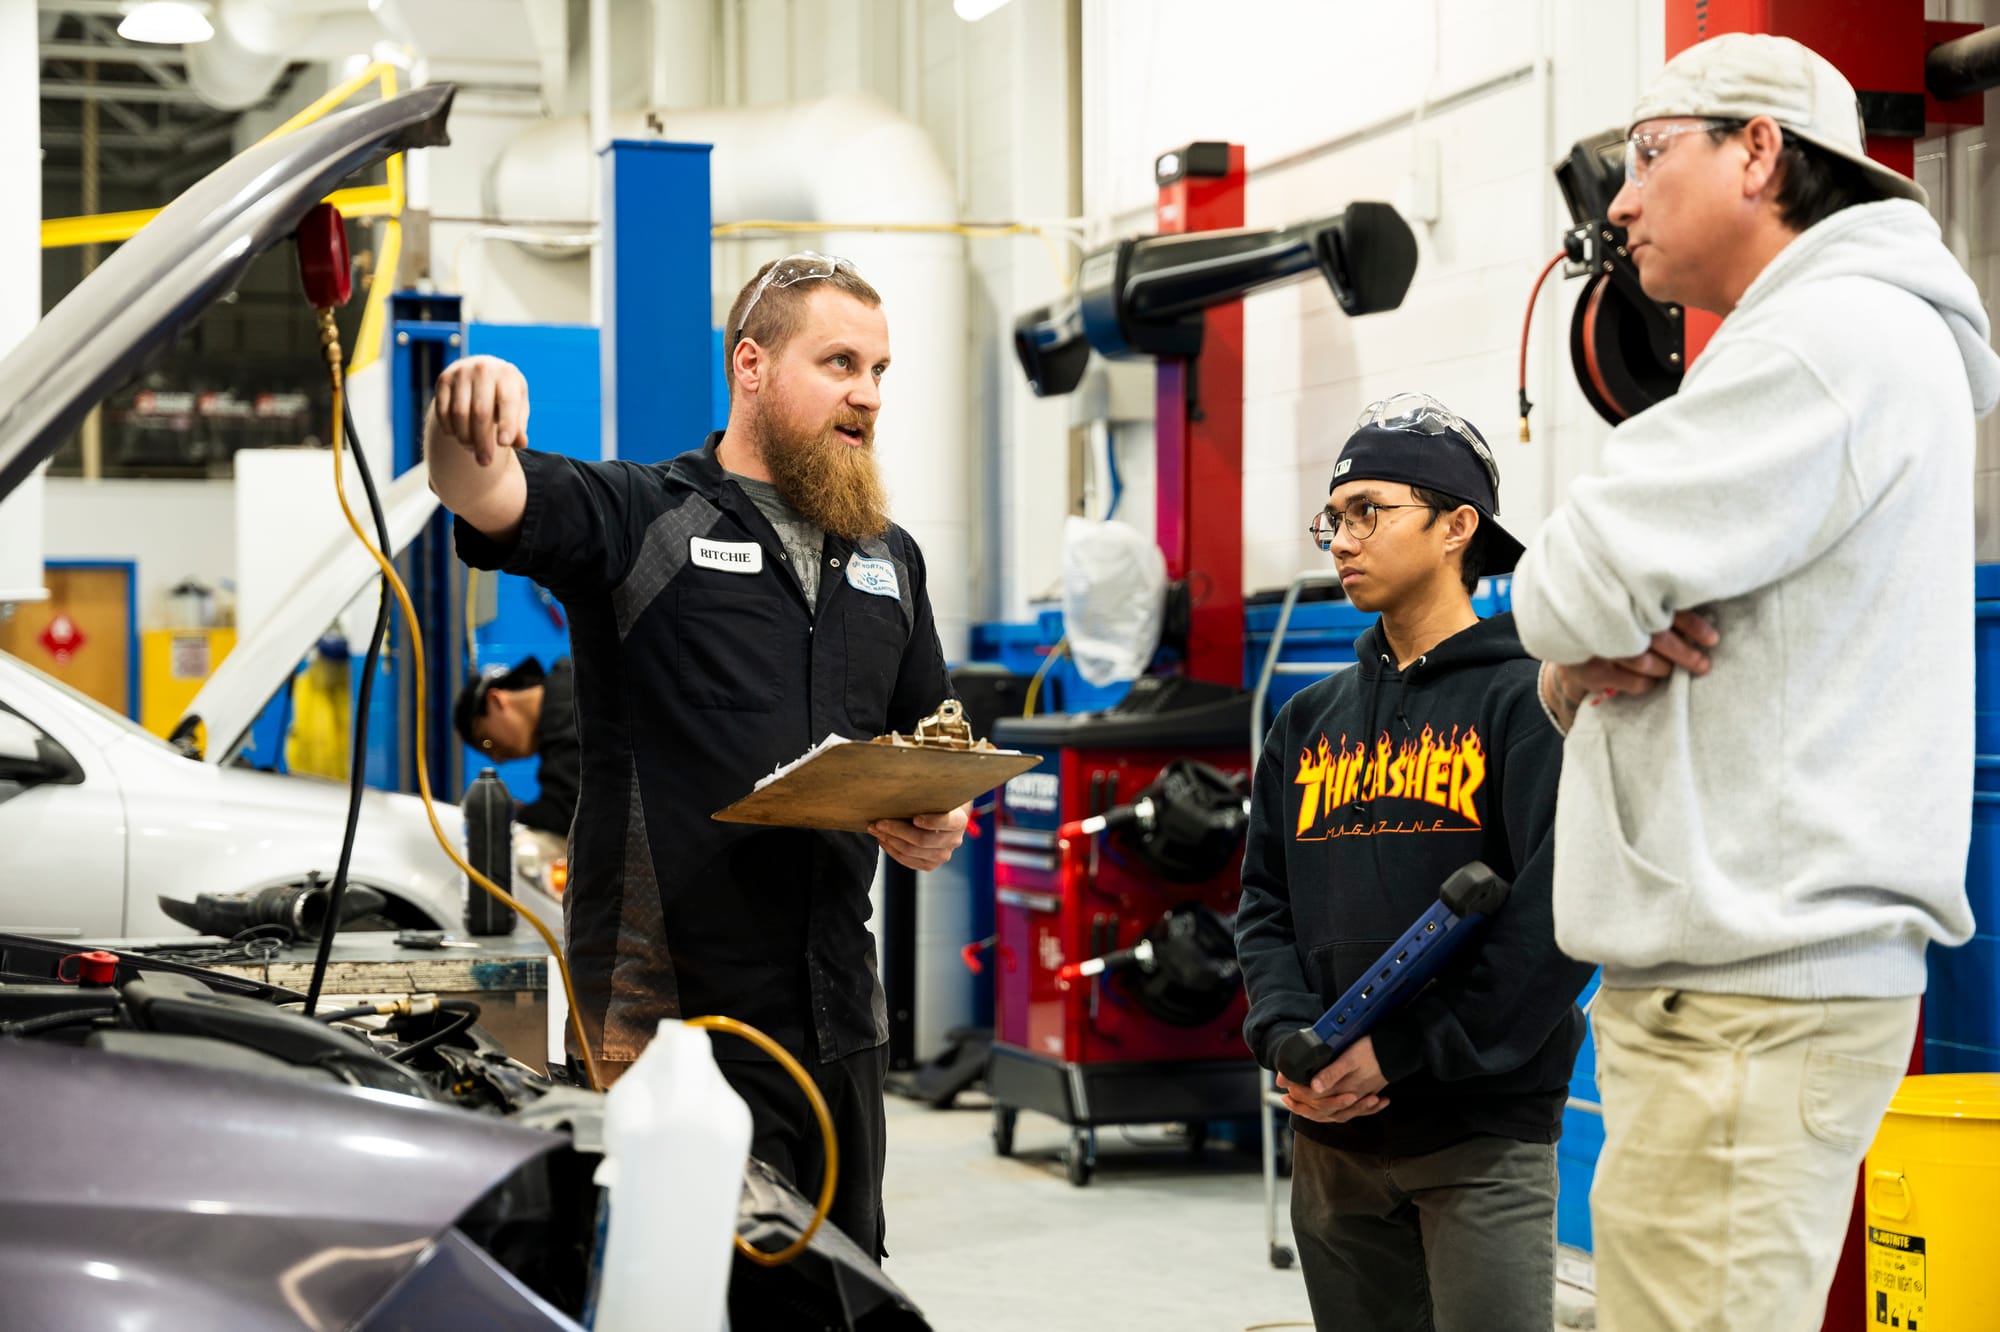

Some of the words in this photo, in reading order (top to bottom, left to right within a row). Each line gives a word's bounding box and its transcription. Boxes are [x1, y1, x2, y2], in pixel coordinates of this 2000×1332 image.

[700, 548, 751, 563] RITCHIE
[1294, 722, 1486, 837] THRASHER
[1326, 820, 1444, 840] MAGAZINE
